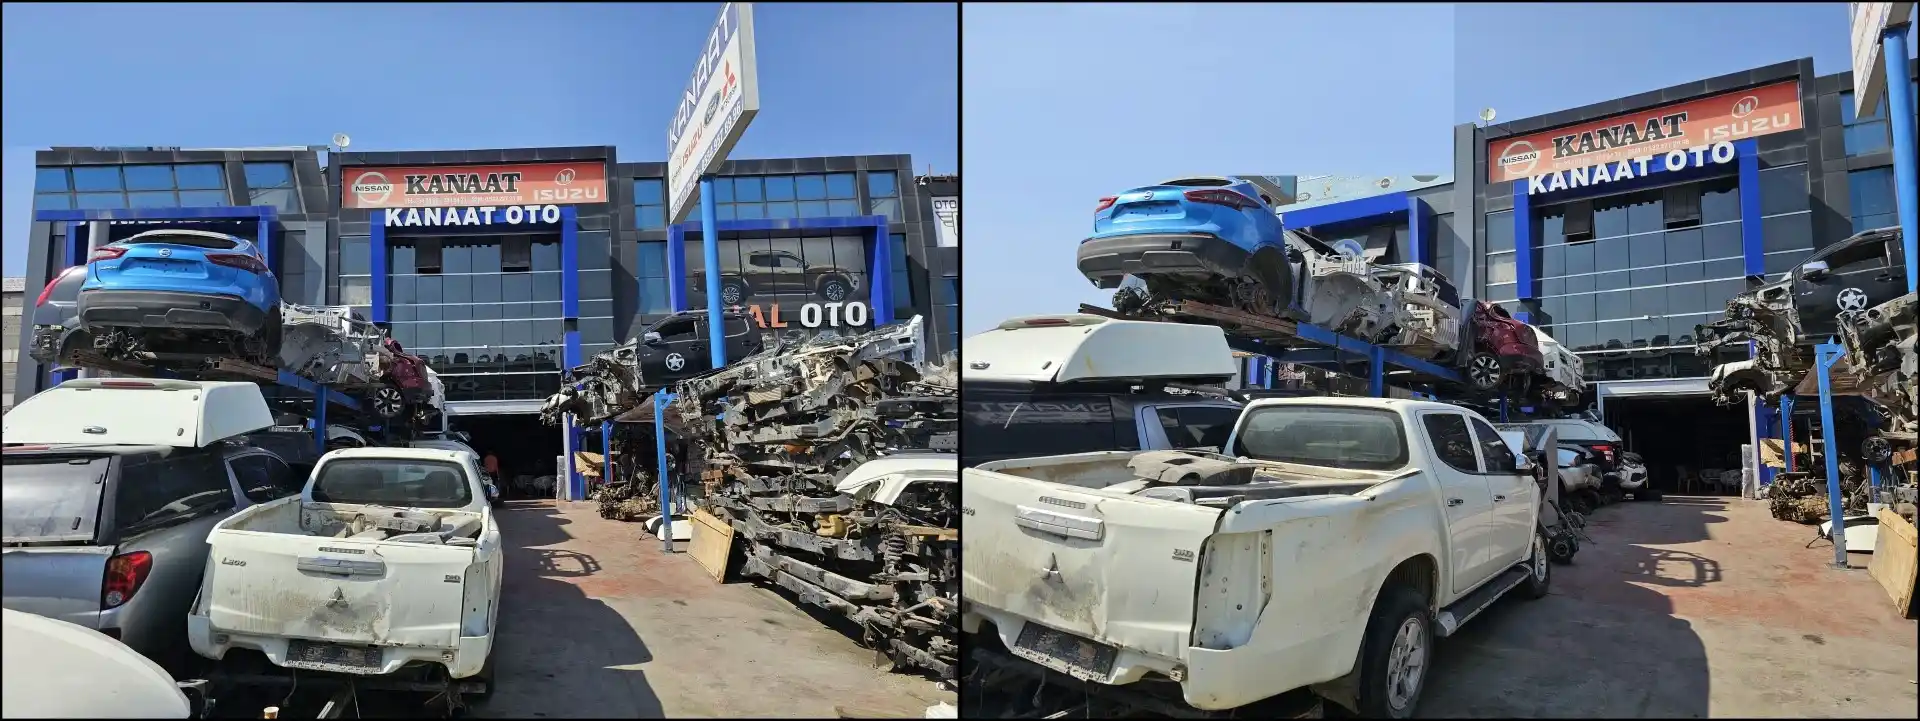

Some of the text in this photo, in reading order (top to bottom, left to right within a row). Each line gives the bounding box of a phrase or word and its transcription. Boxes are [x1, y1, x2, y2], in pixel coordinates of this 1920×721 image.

[667, 2, 732, 152] KANAAT
[1552, 112, 1688, 160] KANAAT
[1704, 113, 1790, 141] ISUZU
[1502, 152, 1537, 164] NISSAN
[1528, 154, 1653, 195] KANAAT
[1665, 141, 1735, 171] OTO
[405, 172, 521, 195] KANAAT
[533, 188, 599, 202] ISUZU
[385, 205, 560, 227] KANAAT OTO
[800, 301, 867, 328] OTO
